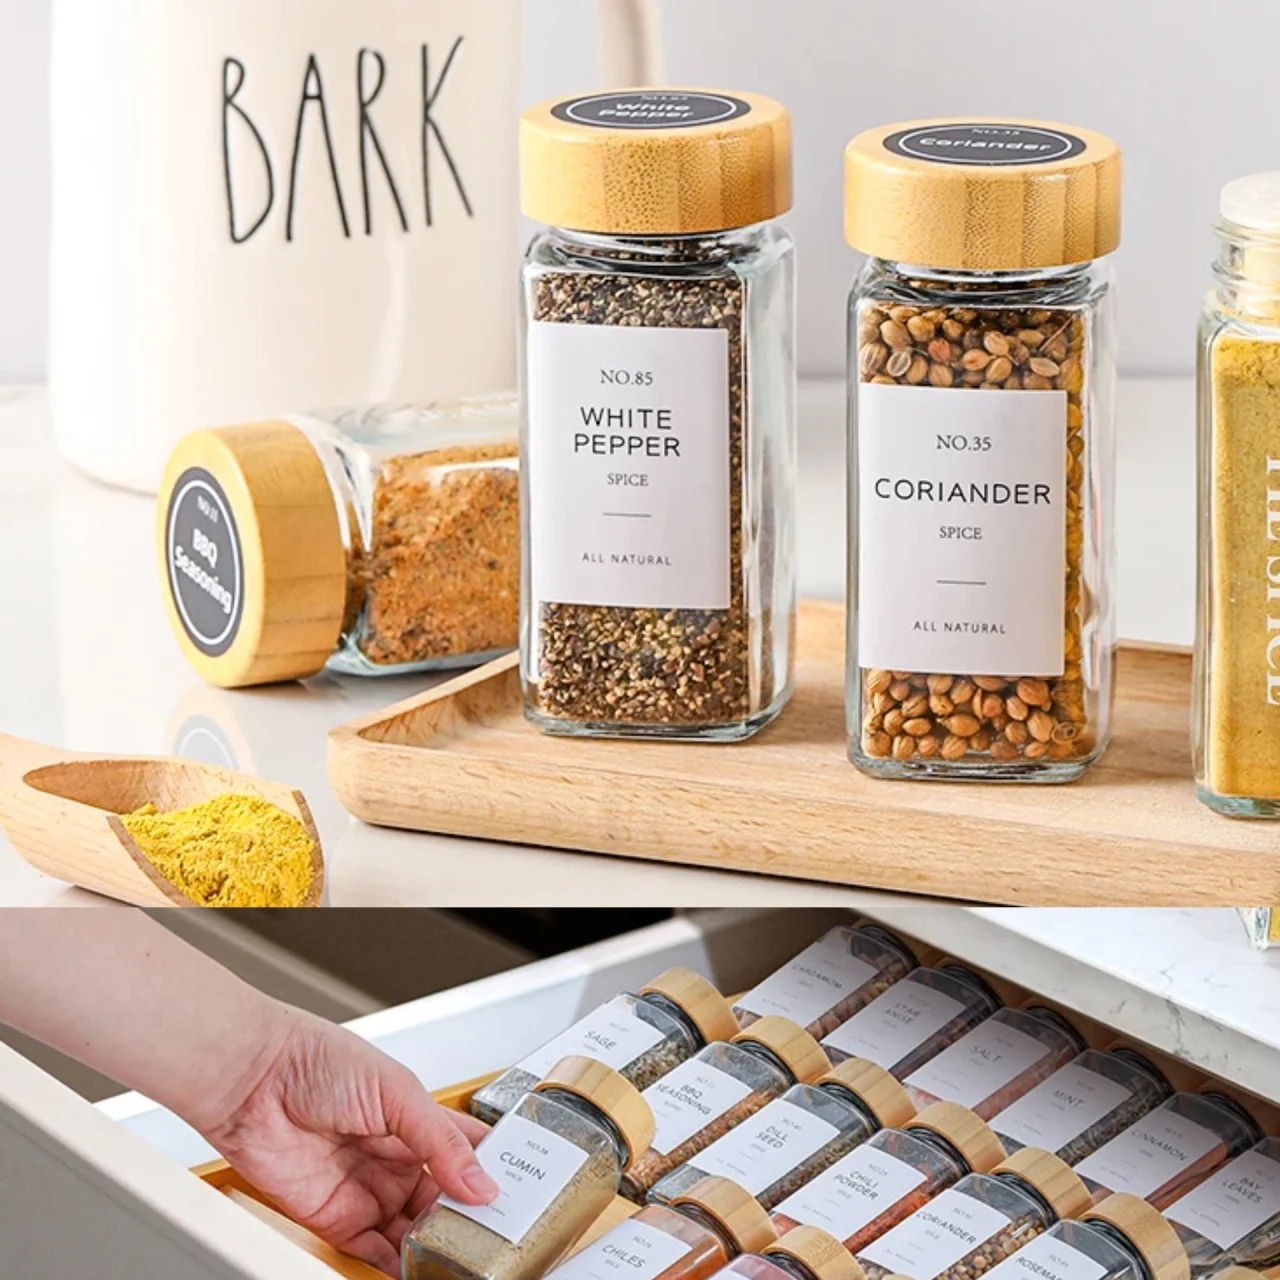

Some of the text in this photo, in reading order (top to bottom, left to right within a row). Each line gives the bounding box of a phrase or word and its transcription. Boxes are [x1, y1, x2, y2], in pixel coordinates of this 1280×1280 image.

[222, 36, 474, 243] BARK
[919, 137, 1053, 151] Coriander
[600, 369, 654, 386] NO.85
[580, 406, 672, 430] WHITE
[574, 433, 681, 457] PEPPER
[936, 434, 992, 451] NO.35
[607, 473, 649, 487] SPICE
[874, 477, 1052, 505] CORIANDER
[939, 526, 983, 541] SPICE
[192, 528, 218, 568] BBQ
[582, 553, 672, 566] ALL NATURAL
[174, 545, 233, 615] Seasoning
[913, 620, 1006, 635] ALL NATURAL
[584, 1029, 618, 1052] SAGE
[971, 1044, 1003, 1064] SALT
[654, 1083, 713, 1117] SEASONING
[679, 1083, 704, 1100] BBQ
[1053, 1090, 1086, 1108] MINT
[754, 1131, 785, 1150] SEED
[764, 1124, 789, 1142] DILL
[1130, 1128, 1188, 1163] CINNAMON
[498, 1150, 548, 1181] CUMIN
[833, 1174, 879, 1201] POWDER
[849, 1169, 880, 1189] CHILI
[1238, 1175, 1263, 1192] BAY
[1221, 1179, 1263, 1205] LEAVES
[915, 1210, 978, 1246] CORIANDER
[602, 1243, 647, 1270] CHILES
